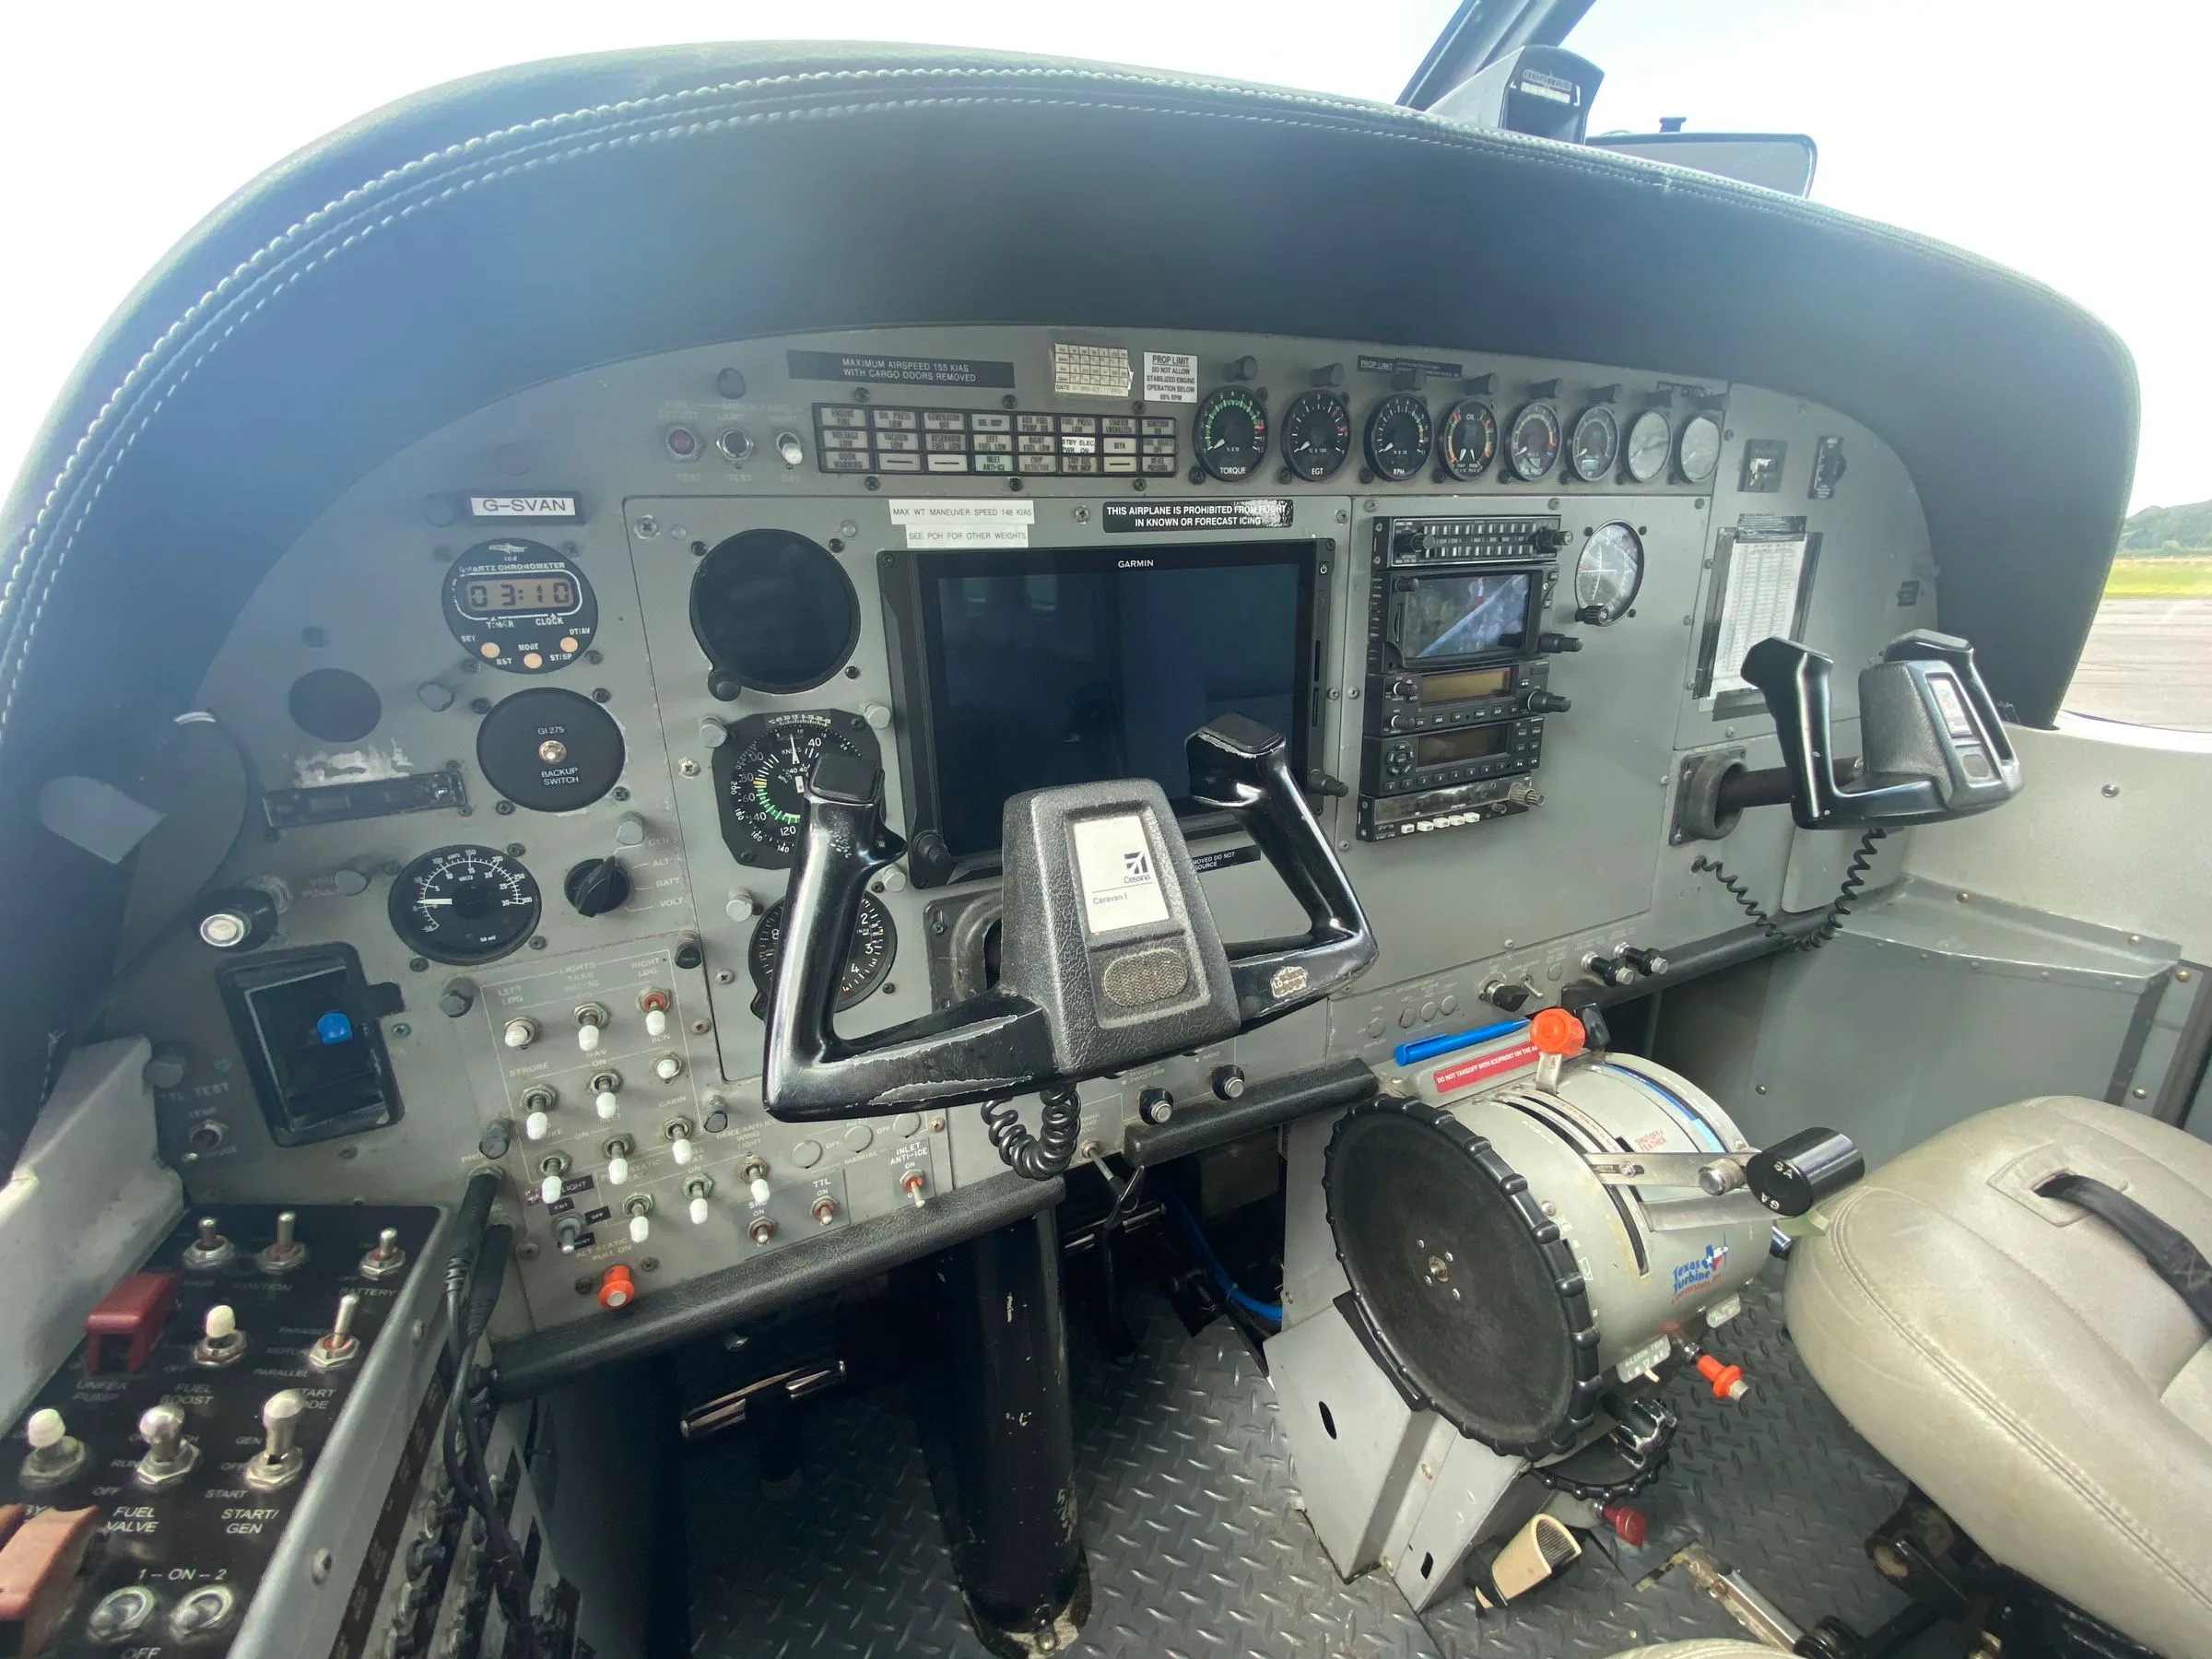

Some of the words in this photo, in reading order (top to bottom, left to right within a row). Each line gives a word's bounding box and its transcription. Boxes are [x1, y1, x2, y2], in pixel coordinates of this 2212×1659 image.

[841, 358, 886, 369] MAXIMUM
[888, 360, 931, 371] AIRSPEED
[934, 361, 948, 371] 155
[950, 362, 969, 372] KIAS
[1152, 355, 1171, 364] PROP
[1172, 356, 1189, 365] LIMIT
[843, 368, 866, 378] WITH
[868, 369, 900, 380] CARGO
[902, 371, 934, 381] DOORS
[935, 372, 977, 382] REMOVED
[1147, 375, 1175, 383] STABILIZED
[1147, 384, 1176, 393] OPERATION
[1177, 385, 1195, 394] BELOW
[1465, 413, 1477, 421] OIL
[1078, 439, 1095, 447] ELEC
[1219, 466, 1247, 475] TORQUE
[1312, 467, 1324, 476] EGT
[728, 473, 753, 483] TEST
[482, 499, 567, 512] G-SVAN
[1106, 506, 1127, 515] THIS
[1129, 506, 1171, 515] AIRPLANE
[1172, 506, 1182, 515] IS
[1182, 505, 1232, 515] PROHIBITED
[1233, 504, 1257, 514] FROM
[893, 508, 910, 516] MAX
[913, 508, 925, 516] WT
[929, 508, 971, 516] MANEUVER
[974, 508, 998, 516] SPEED
[1001, 508, 1014, 516] 148
[1016, 508, 1033, 516] KIAS
[1135, 518, 1145, 527] IN
[1146, 517, 1179, 527] KNOWN
[1180, 517, 1194, 526] OR
[1194, 516, 1238, 526] FORECAST
[1239, 516, 1262, 526] ICING
[909, 532, 923, 540] SEE
[927, 532, 944, 540] POH
[947, 532, 963, 540] FOR
[966, 532, 991, 540] OTHER
[994, 532, 1027, 541] WEIGHTS
[497, 562, 566, 571] CHRONOMETER
[1117, 559, 1154, 569] GARMIN
[470, 582, 570, 607] 03:10
[485, 619, 514, 629] TIMER
[535, 617, 564, 627] CLOCK
[518, 642, 539, 652] MODE
[496, 657, 512, 666] RST
[549, 653, 572, 662] ST/SP
[537, 727, 548, 735] GI
[548, 725, 565, 735] 275
[807, 737, 822, 747] 40
[540, 767, 579, 779] BACKUP
[543, 775, 580, 786] SWITCH
[730, 781, 738, 795] 200
[780, 826, 796, 837] 120
[777, 843, 790, 853] 140
[491, 855, 504, 864] 200
[1223, 851, 1235, 859] NOT
[652, 857, 670, 867] ALT
[1193, 861, 1218, 871] SOURCE
[513, 873, 525, 881] 250
[655, 877, 680, 888] BATT
[1124, 874, 1151, 885] Cessna
[659, 897, 684, 908] VOLT
[1091, 892, 1124, 905] Caravan
[860, 912, 869, 924] 2
[771, 928, 780, 940] 8
[865, 943, 874, 954] 3
[637, 968, 658, 978] LDG
[851, 962, 860, 973] 4
[1273, 980, 1284, 989] LO
[498, 985, 523, 996] LEFT
[500, 995, 524, 1006] LDG
[591, 1058, 607, 1067] ON
[1436, 1075, 1446, 1084] DO
[1444, 1072, 1457, 1082] NOT
[1455, 1065, 1478, 1078] TAKEOFF
[1478, 1060, 1491, 1070] WITH
[1514, 1050, 1523, 1058] ON
[1522, 1047, 1532, 1056] THE
[193, 1081, 229, 1097] TEST
[658, 1094, 688, 1108] CABIN
[876, 1125, 891, 1135] OFF
[573, 1132, 590, 1141] ON
[736, 1132, 760, 1143] WING
[895, 1141, 922, 1156] INLET
[844, 1150, 878, 1166] MANUAL
[889, 1147, 929, 1166] ANTI-ICE
[688, 1165, 701, 1174] ON
[904, 1160, 916, 1170] ON
[561, 1181, 589, 1193] LIGHT
[812, 1178, 831, 1189] TTL
[817, 1187, 829, 1197] ON
[590, 1212, 605, 1221] OFF
[752, 1207, 765, 1217] ON
[575, 1247, 593, 1259] ALT
[595, 1236, 629, 1253] STATIC
[592, 1251, 614, 1262] PULL
[618, 1244, 633, 1254] ON
[253, 1367, 310, 1379] PARALLEL
[173, 1383, 213, 1394] FUEL
[159, 1394, 215, 1406] BOOST
[235, 1435, 264, 1446] GEN
[110, 1459, 138, 1470] RUN
[92, 1486, 122, 1498] OFF
[205, 1488, 248, 1500] START
[112, 1506, 157, 1519] FUEL
[220, 1508, 280, 1522] START/
[106, 1521, 159, 1534] VALVE
[225, 1522, 264, 1535] GEN
[137, 1568, 147, 1581] 1
[167, 1568, 198, 1581] ON
[214, 1568, 229, 1581] 2
[122, 1646, 161, 1659] OFF
